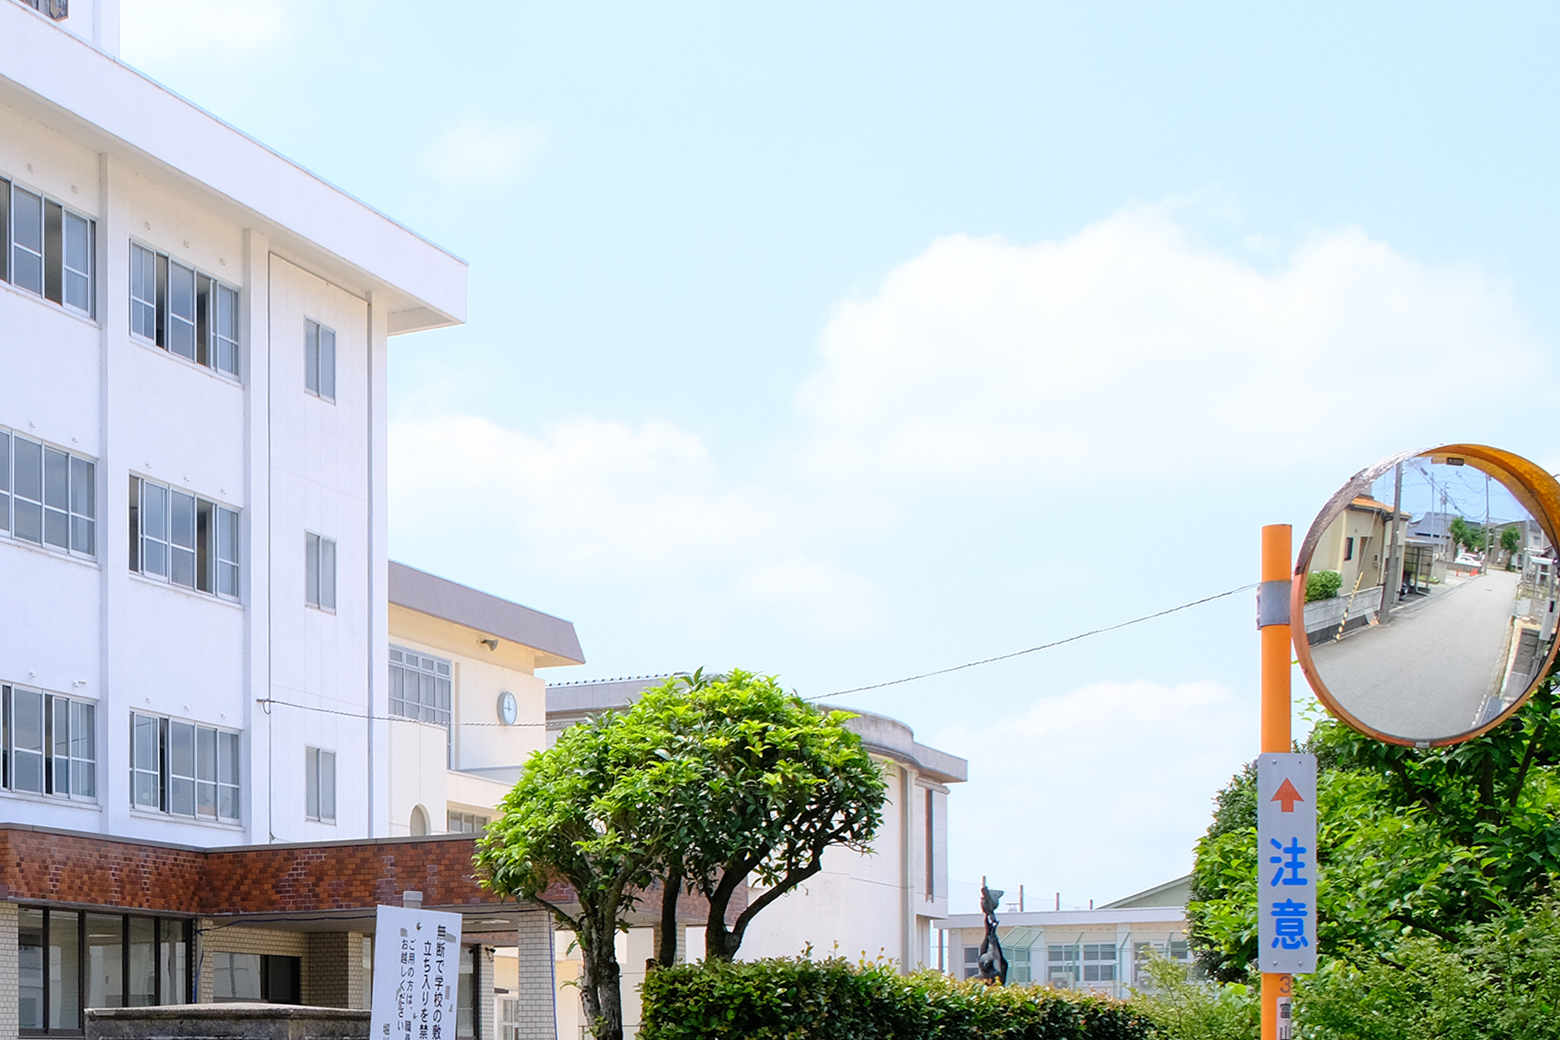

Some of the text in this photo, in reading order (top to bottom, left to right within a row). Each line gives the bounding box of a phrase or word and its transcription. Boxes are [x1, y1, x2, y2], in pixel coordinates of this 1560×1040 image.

[1269, 836, 1309, 950] 注意
[397, 939, 408, 1031] お越しください
